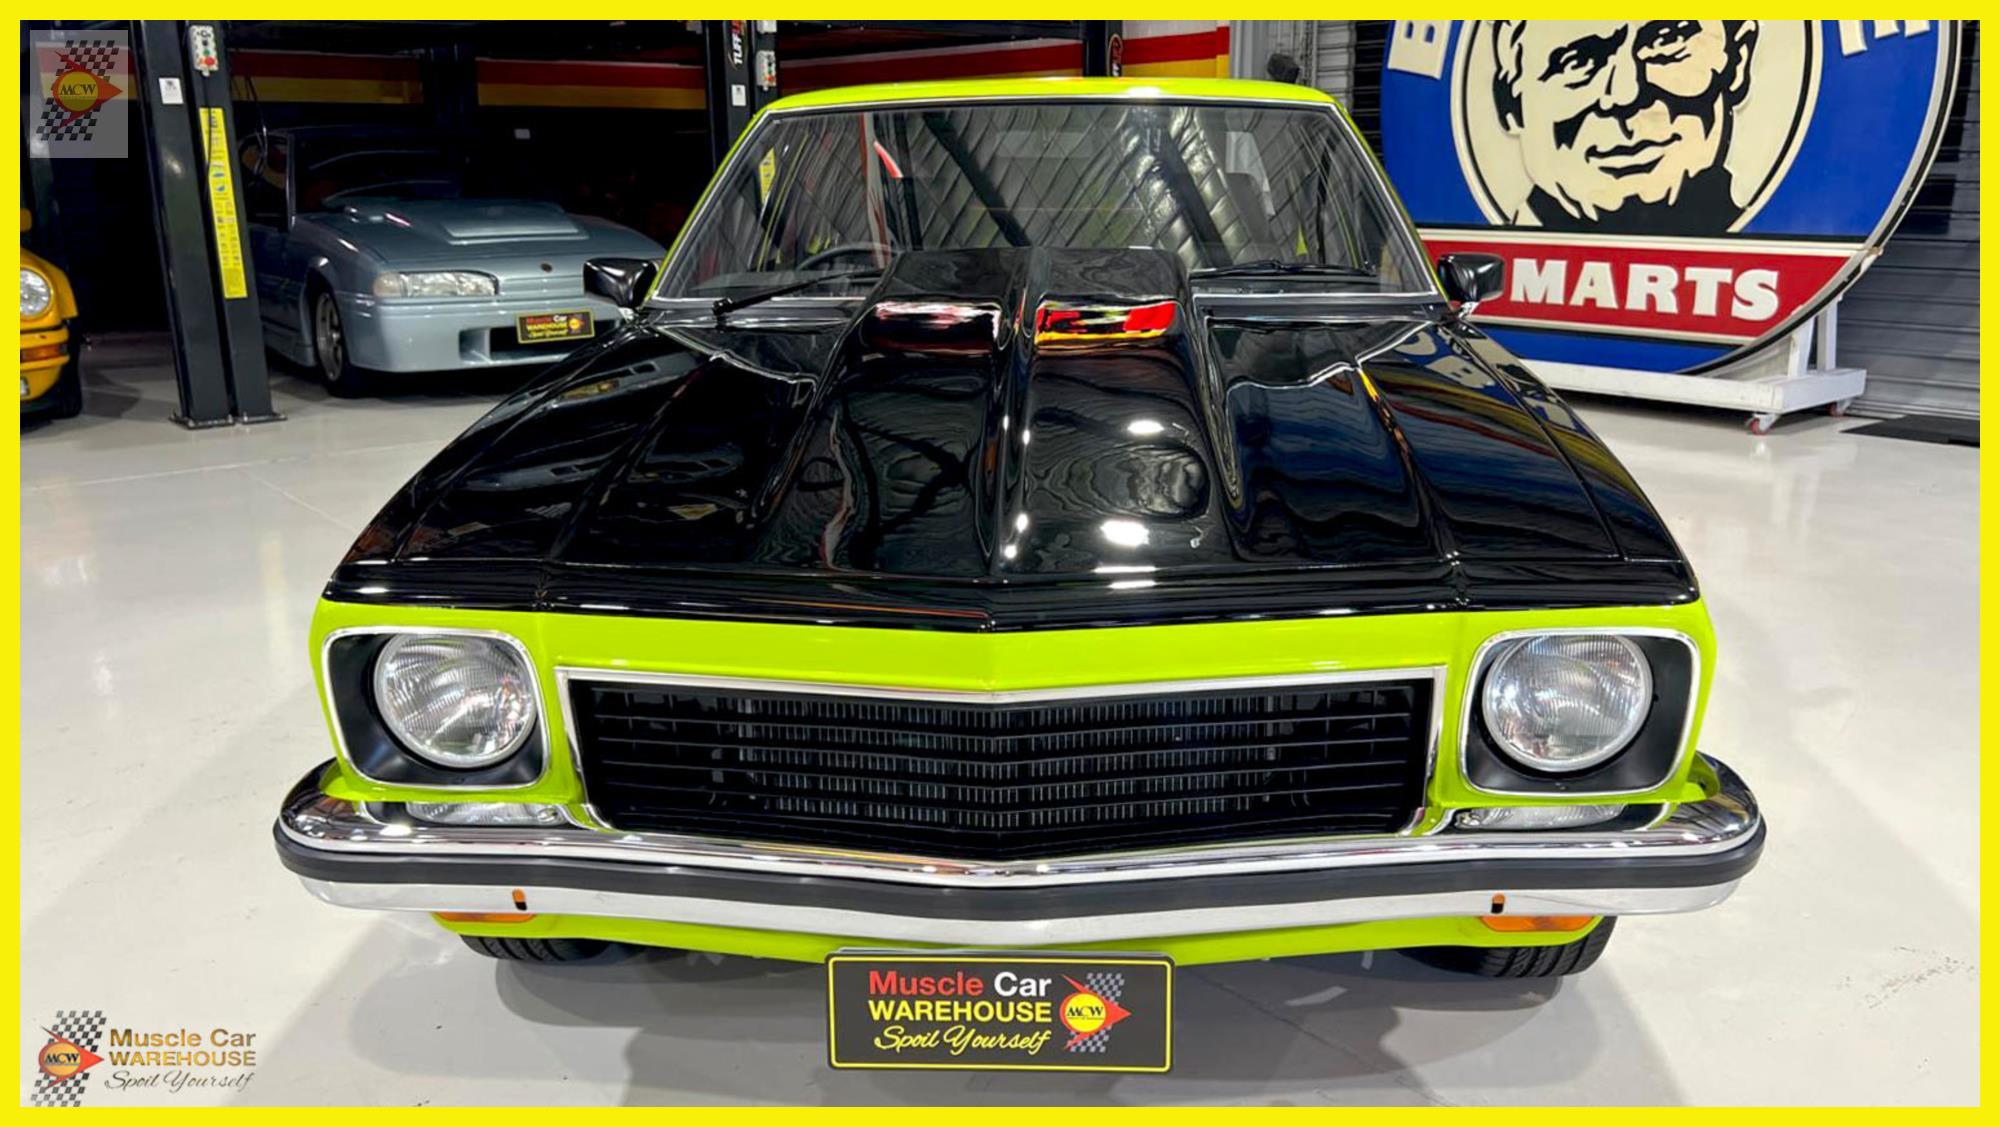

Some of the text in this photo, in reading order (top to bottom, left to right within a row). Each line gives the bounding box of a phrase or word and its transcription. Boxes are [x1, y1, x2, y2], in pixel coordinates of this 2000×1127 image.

[1510, 258, 1781, 321] MARTS
[869, 970, 1052, 997] Muscle Car
[868, 1000, 1052, 1022] WAREHOUSE
[1066, 1006, 1104, 1018] MCW
[874, 1025, 1052, 1055] Spoil Yourself
